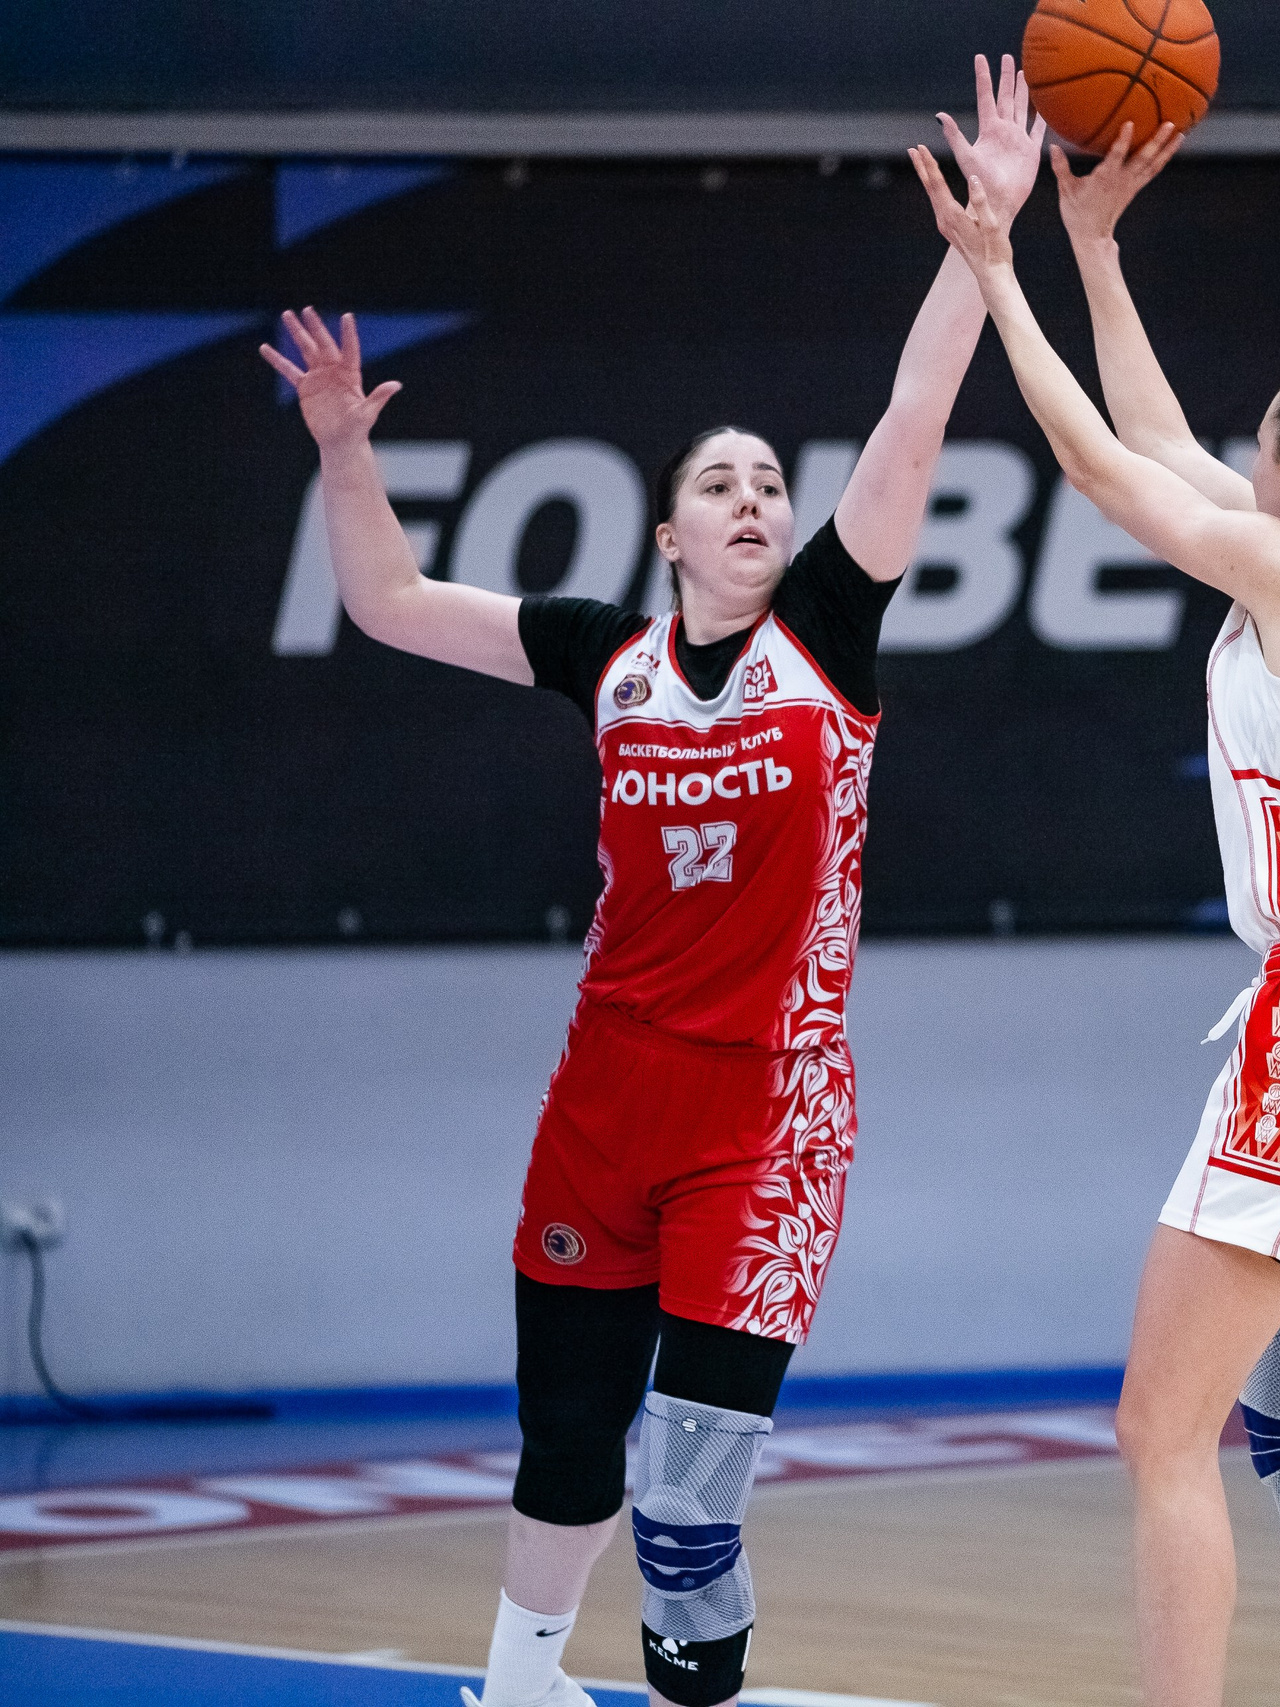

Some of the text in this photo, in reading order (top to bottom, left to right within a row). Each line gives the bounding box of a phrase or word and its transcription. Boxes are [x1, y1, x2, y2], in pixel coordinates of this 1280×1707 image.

[270, 436, 1260, 658] FOBE
[618, 726, 784, 760] БАСКЕТБОЛЬНЫЙ КЛУБ
[611, 757, 793, 806] ЮНОСТЬ
[661, 820, 738, 892] 22
[648, 1638, 699, 1672] KELME
